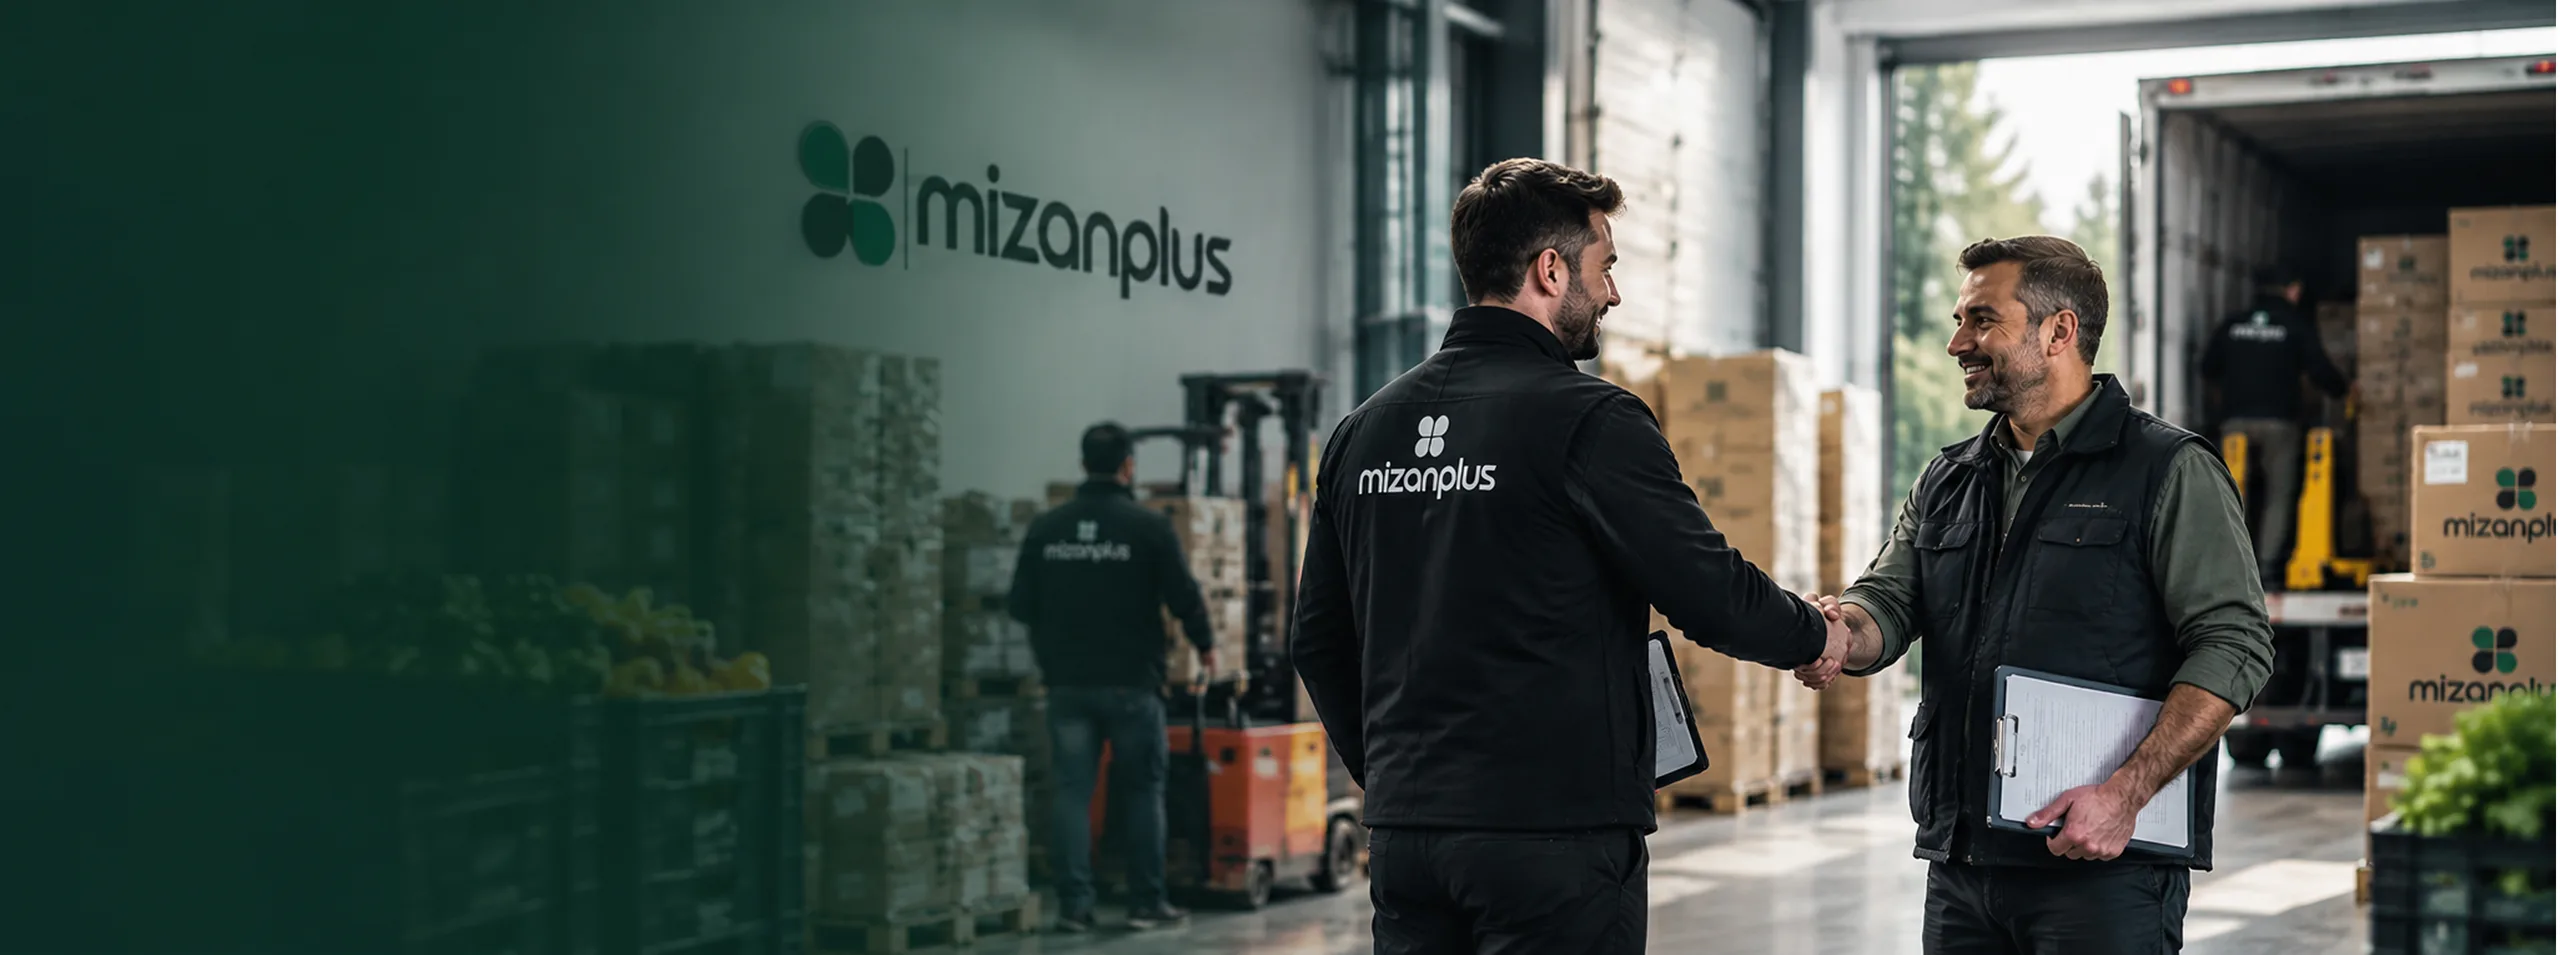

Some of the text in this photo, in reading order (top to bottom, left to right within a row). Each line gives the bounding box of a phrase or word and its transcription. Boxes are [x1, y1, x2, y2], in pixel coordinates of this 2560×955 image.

[916, 163, 1232, 300] mizanplus
[1358, 457, 1497, 500] mizanplus
[2443, 512, 2556, 544] mizanpl
